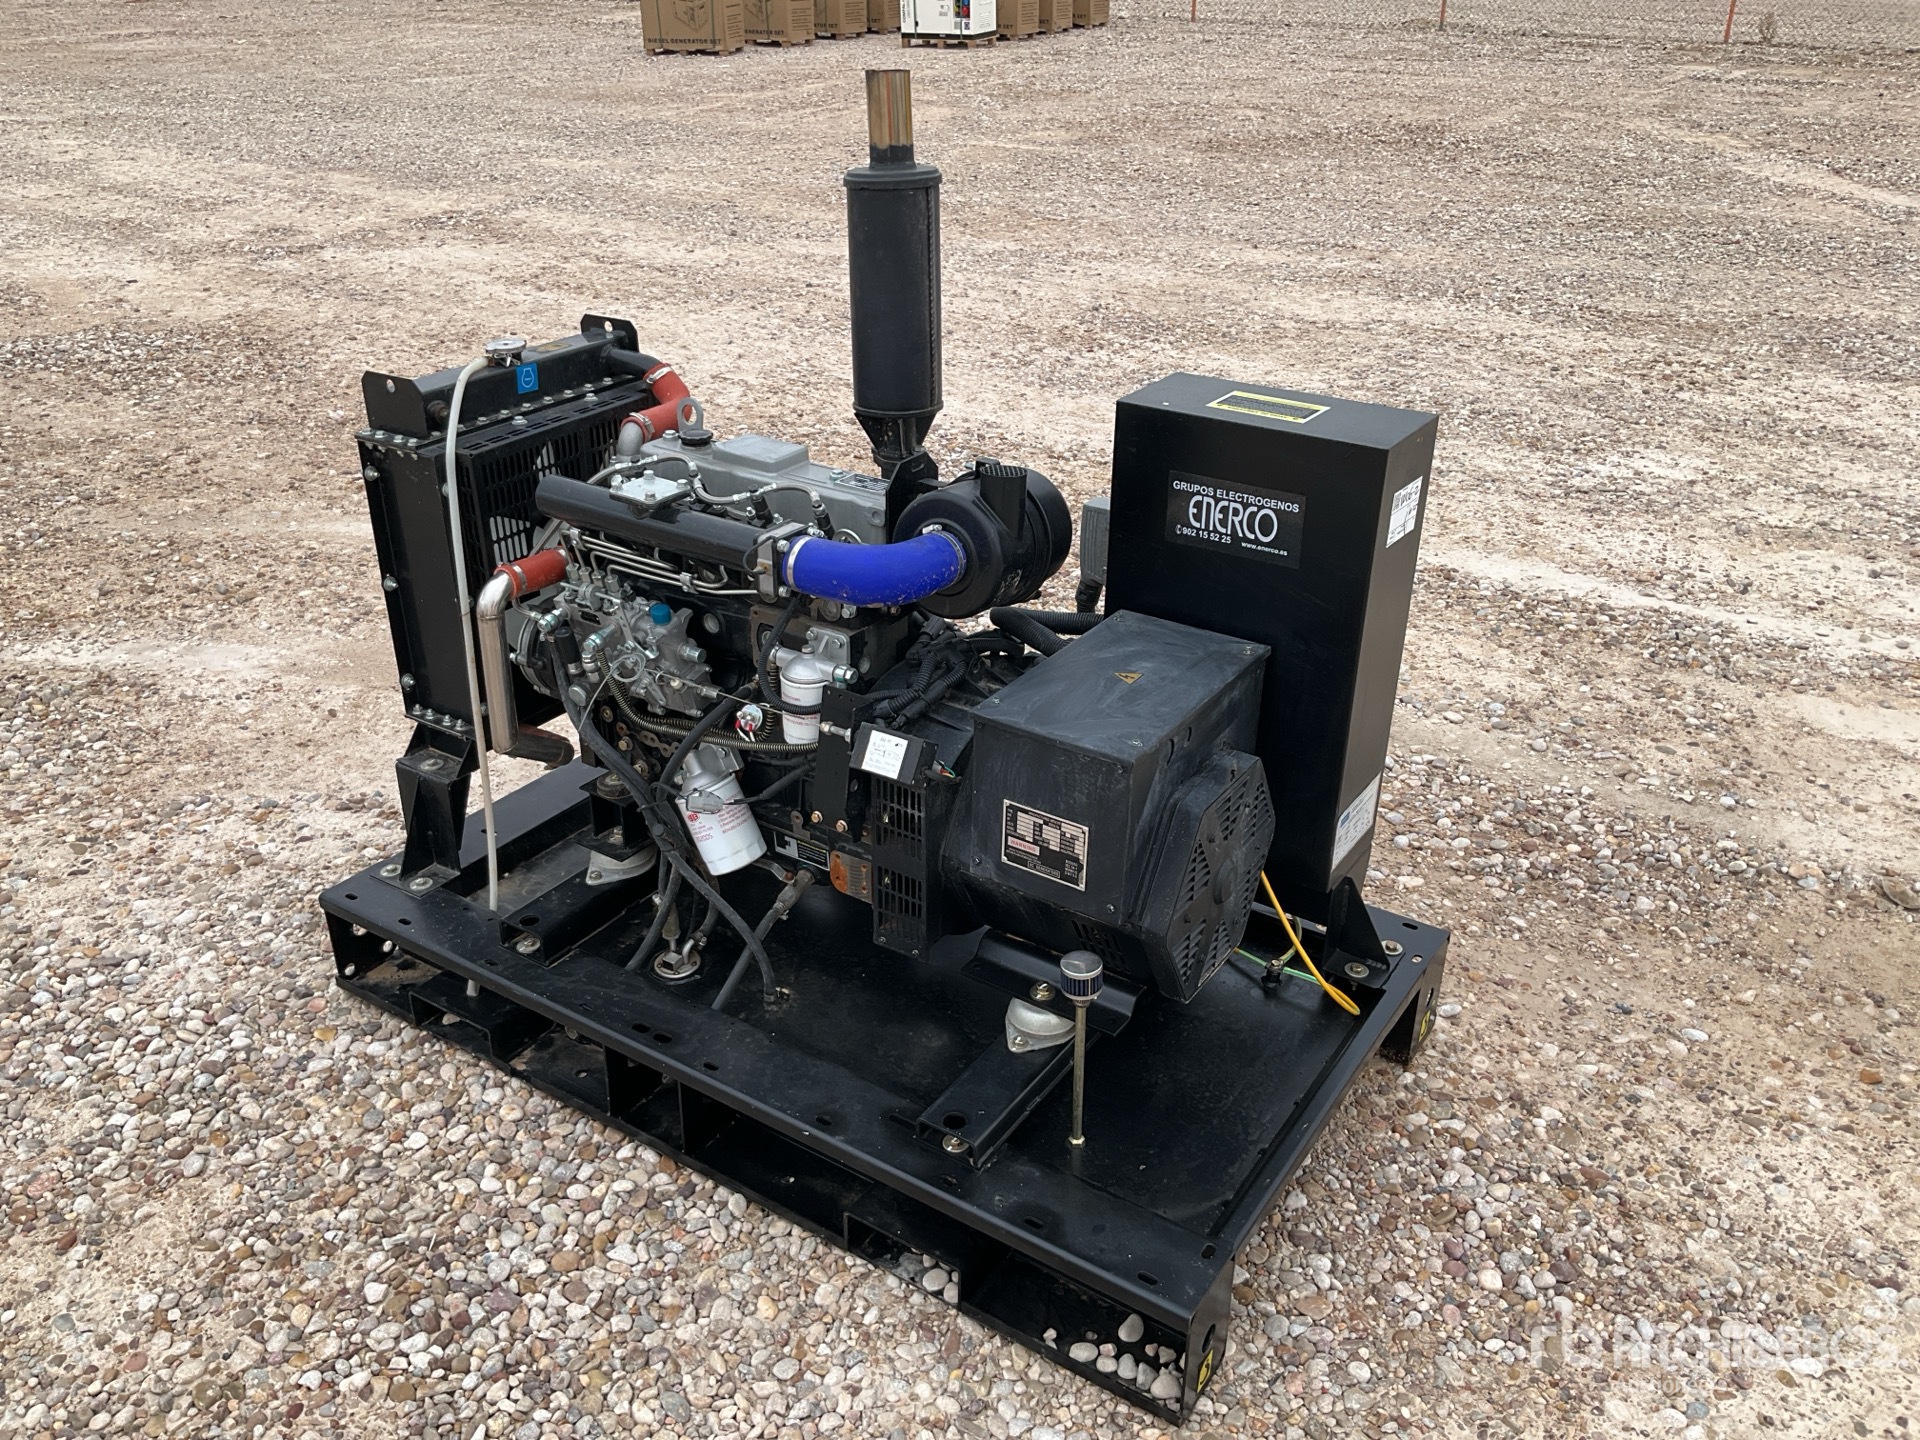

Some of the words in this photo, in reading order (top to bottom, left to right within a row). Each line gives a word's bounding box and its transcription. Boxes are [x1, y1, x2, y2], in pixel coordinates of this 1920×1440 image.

[1173, 480, 1214, 496] GRUPOS
[1216, 489, 1300, 513] ELECTROGENOS
[1182, 526, 1196, 537] 902
[1198, 530, 1208, 539] 15
[1209, 532, 1220, 541] 52
[1221, 534, 1231, 544] 25
[1241, 541, 1288, 556] www.enerco.es
[1010, 838, 1036, 852] WARNING
